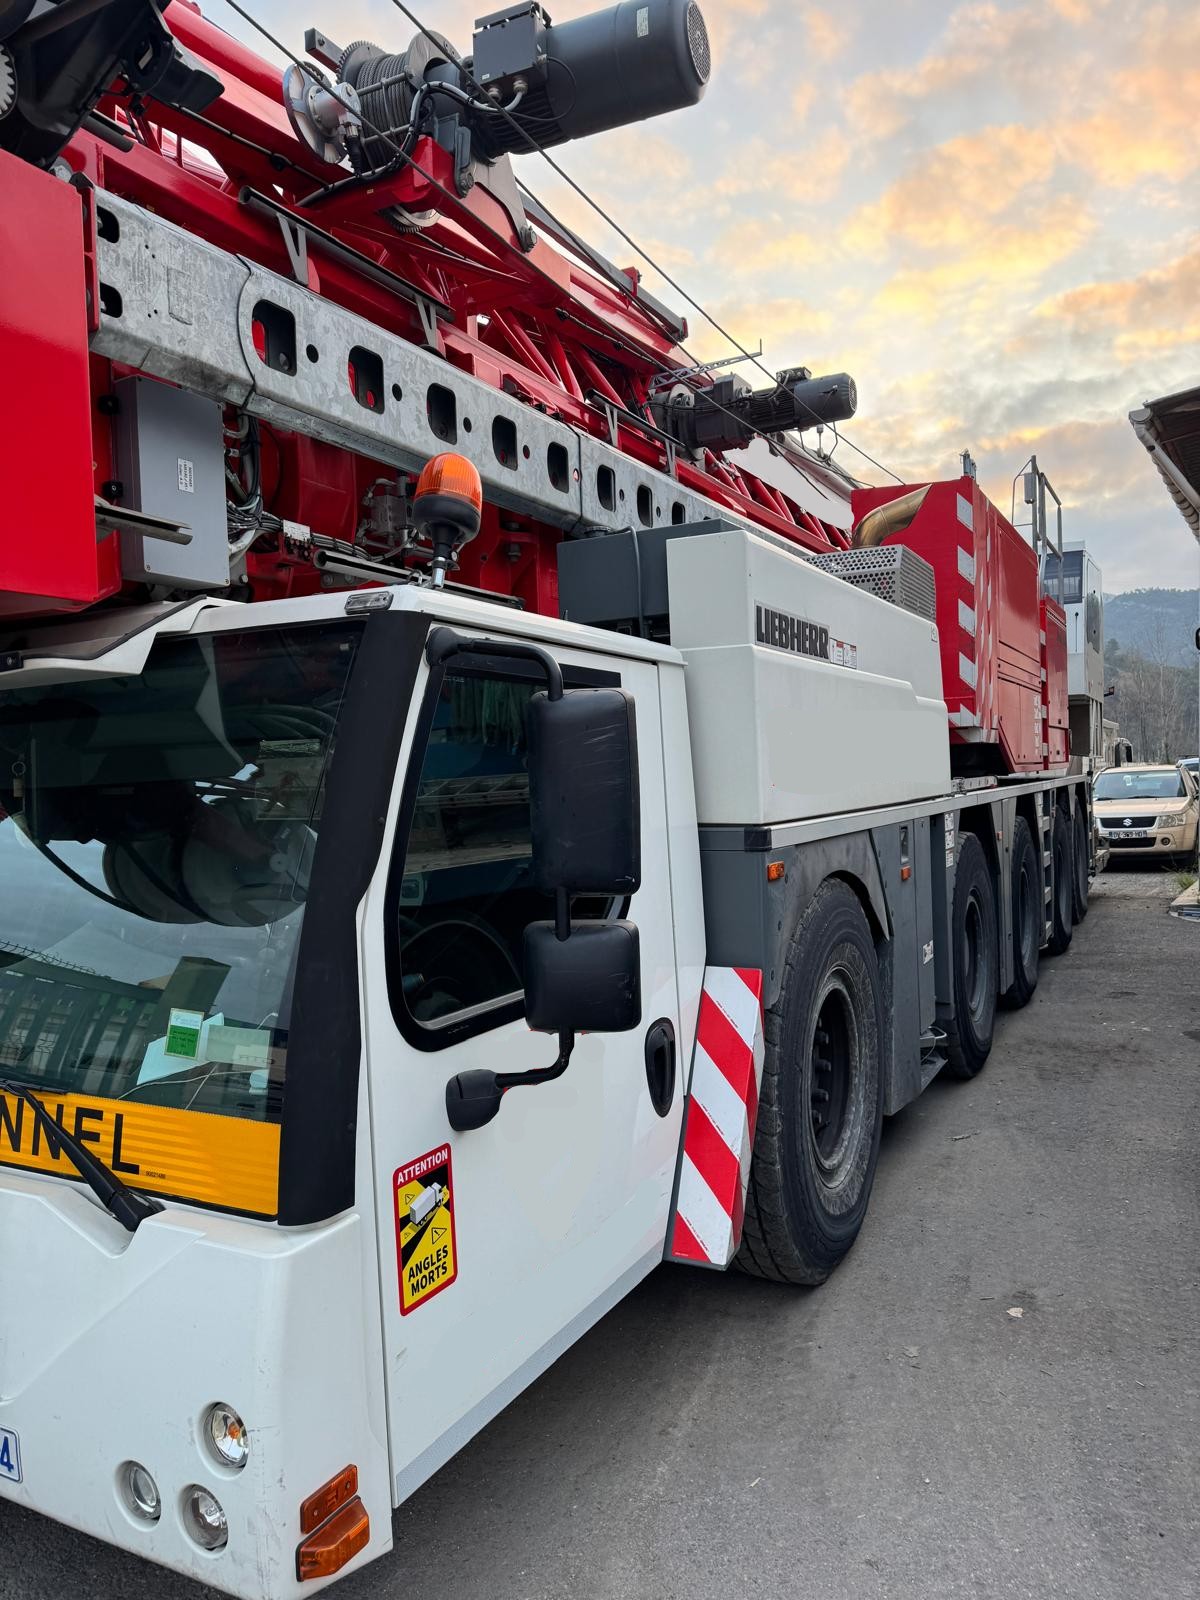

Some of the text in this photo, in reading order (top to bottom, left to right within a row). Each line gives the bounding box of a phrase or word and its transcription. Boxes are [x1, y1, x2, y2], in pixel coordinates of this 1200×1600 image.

[756, 605, 829, 660] LIEBHERR
[397, 1148, 448, 1185] ATTENTION
[408, 1244, 448, 1282] ANGLES
[411, 1261, 447, 1296] MORTS
